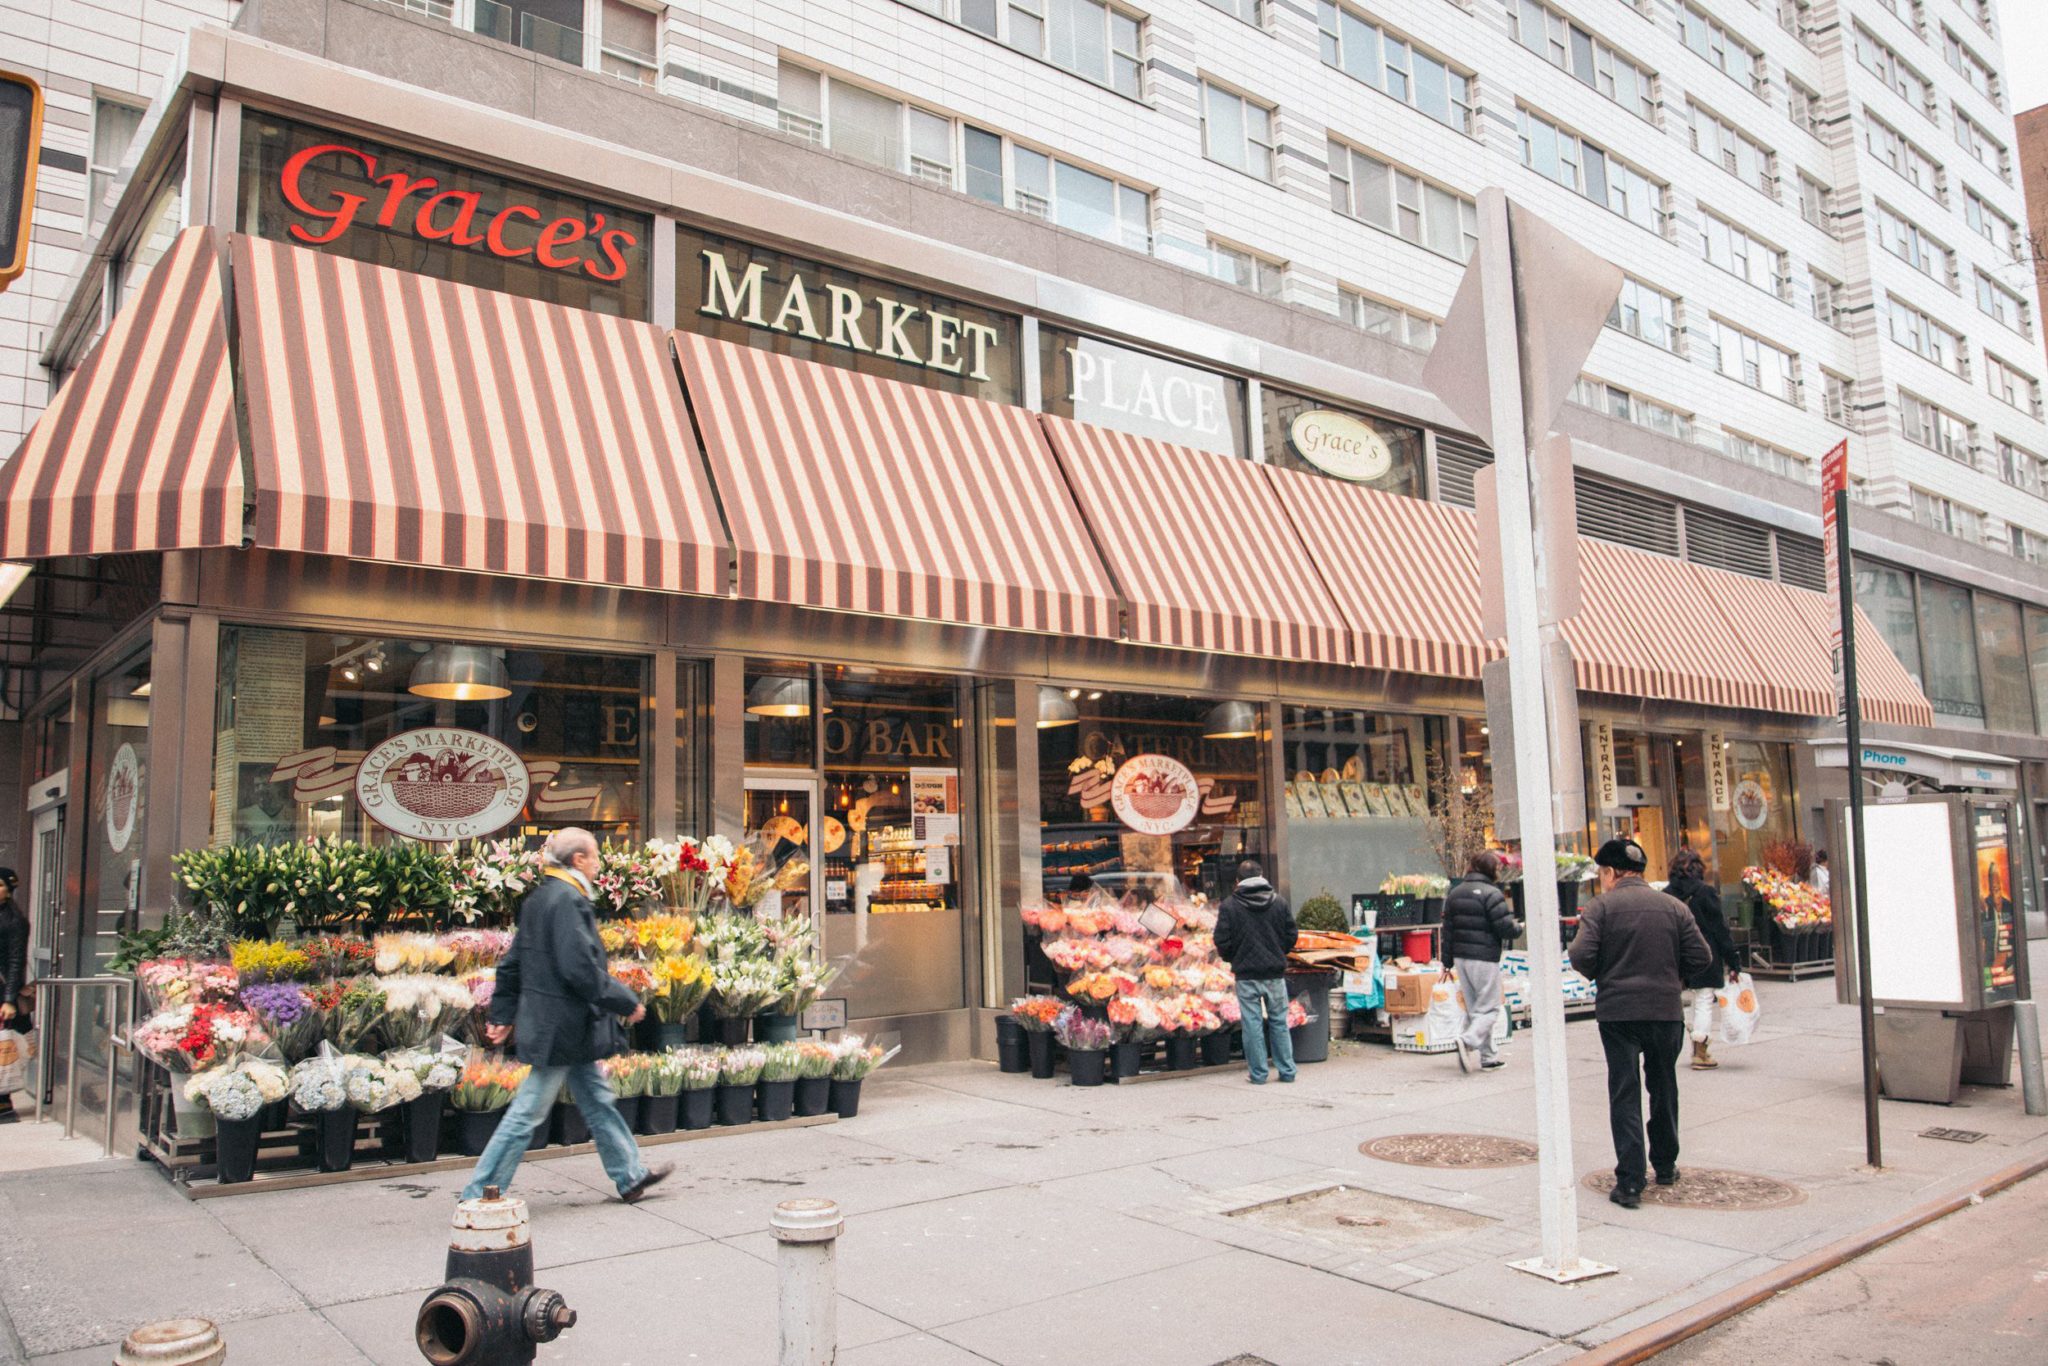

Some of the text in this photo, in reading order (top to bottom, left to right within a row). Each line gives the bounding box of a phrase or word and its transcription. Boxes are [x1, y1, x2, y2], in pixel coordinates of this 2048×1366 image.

[281, 145, 638, 282] Grace's
[701, 249, 1220, 434] MARKET PLACE
[1304, 424, 1379, 460] Grace's
[865, 719, 952, 758] BAR
[1599, 725, 1612, 801] ENTRANCE
[1863, 750, 1907, 765] Phone
[362, 733, 524, 809] GRACE'S MARKETPLACE
[1711, 734, 1723, 804] ENTRANCE
[419, 821, 470, 837] NYC
[1144, 821, 1170, 831] NYC
